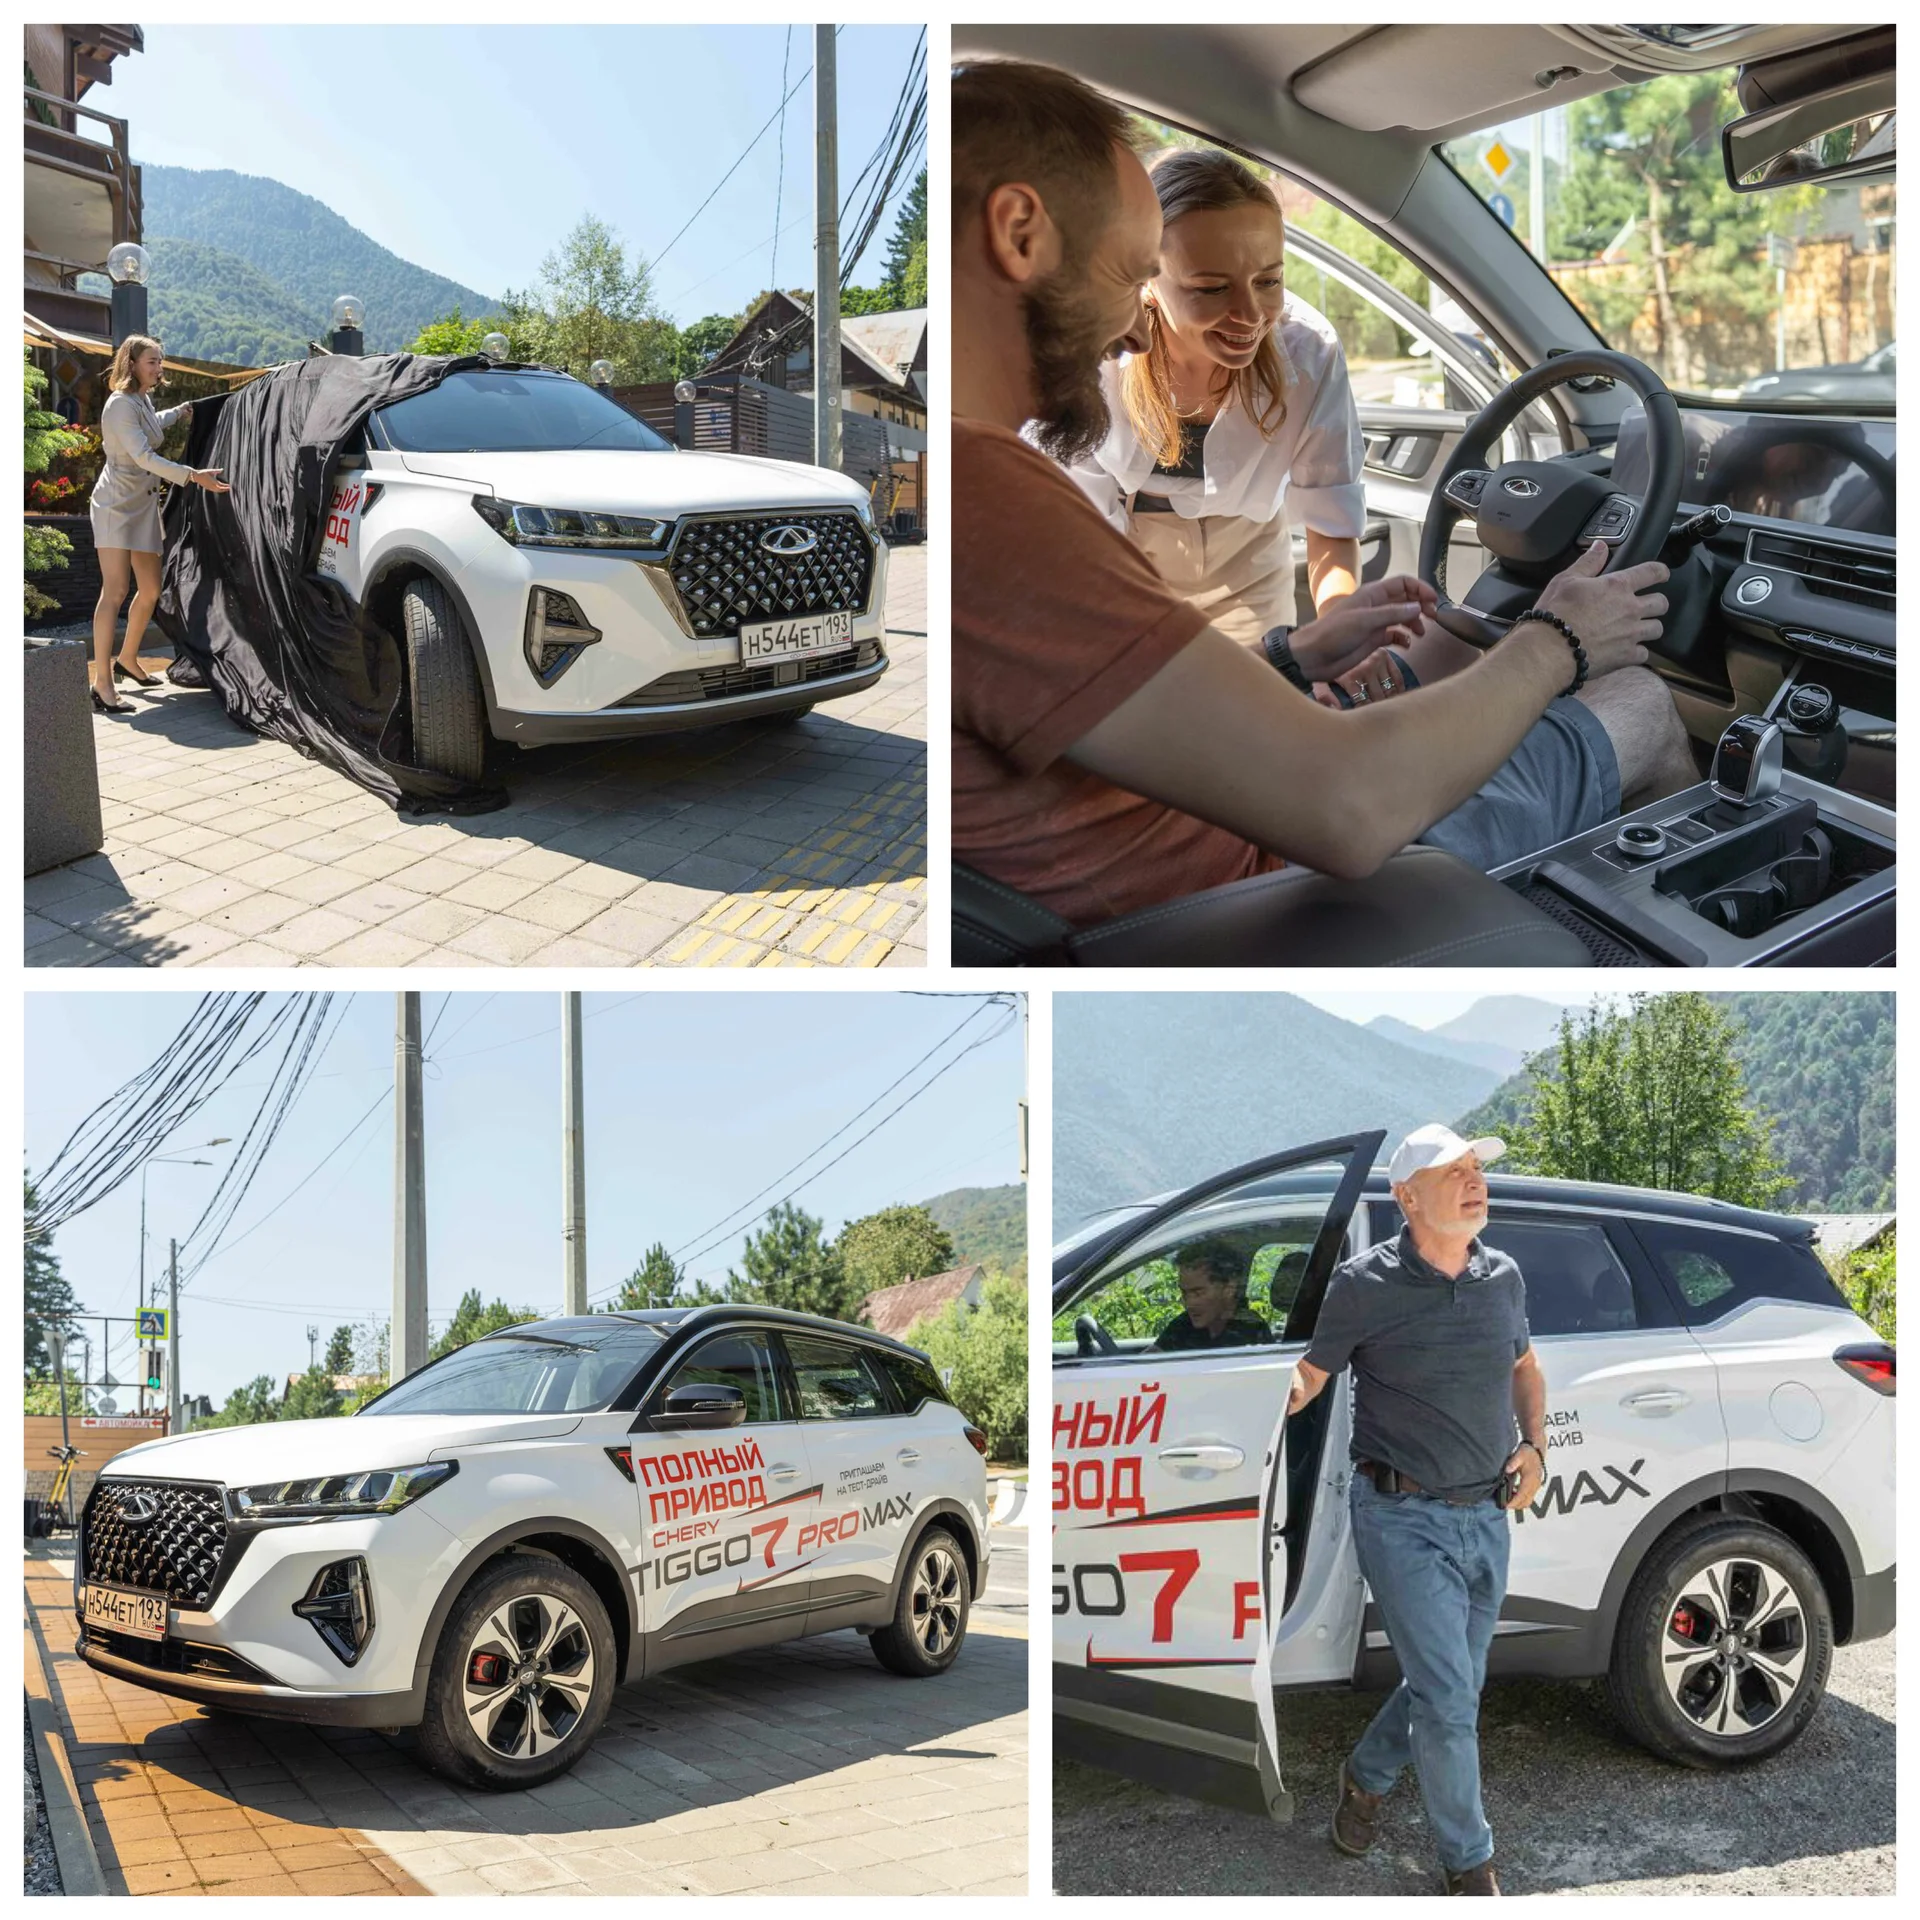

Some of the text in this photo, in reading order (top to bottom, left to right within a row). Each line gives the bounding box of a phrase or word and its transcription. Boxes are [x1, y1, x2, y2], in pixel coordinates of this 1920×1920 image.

[825, 613, 849, 636] 193
[638, 1437, 765, 1488] ПОЛНЫЙ
[839, 1461, 886, 1481] ПРИГЛАШАЕМ
[836, 1474, 889, 1496] НА ТЕСТ-ДРАЙВ
[649, 1475, 767, 1525] ПРИВОД
[627, 1491, 916, 1597] TIGGO 7 PRO MAX
[652, 1518, 720, 1549] CHERY
[138, 1597, 162, 1621] 193
[1118, 1548, 1201, 1644] 7
[142, 1619, 155, 1629] RUS
